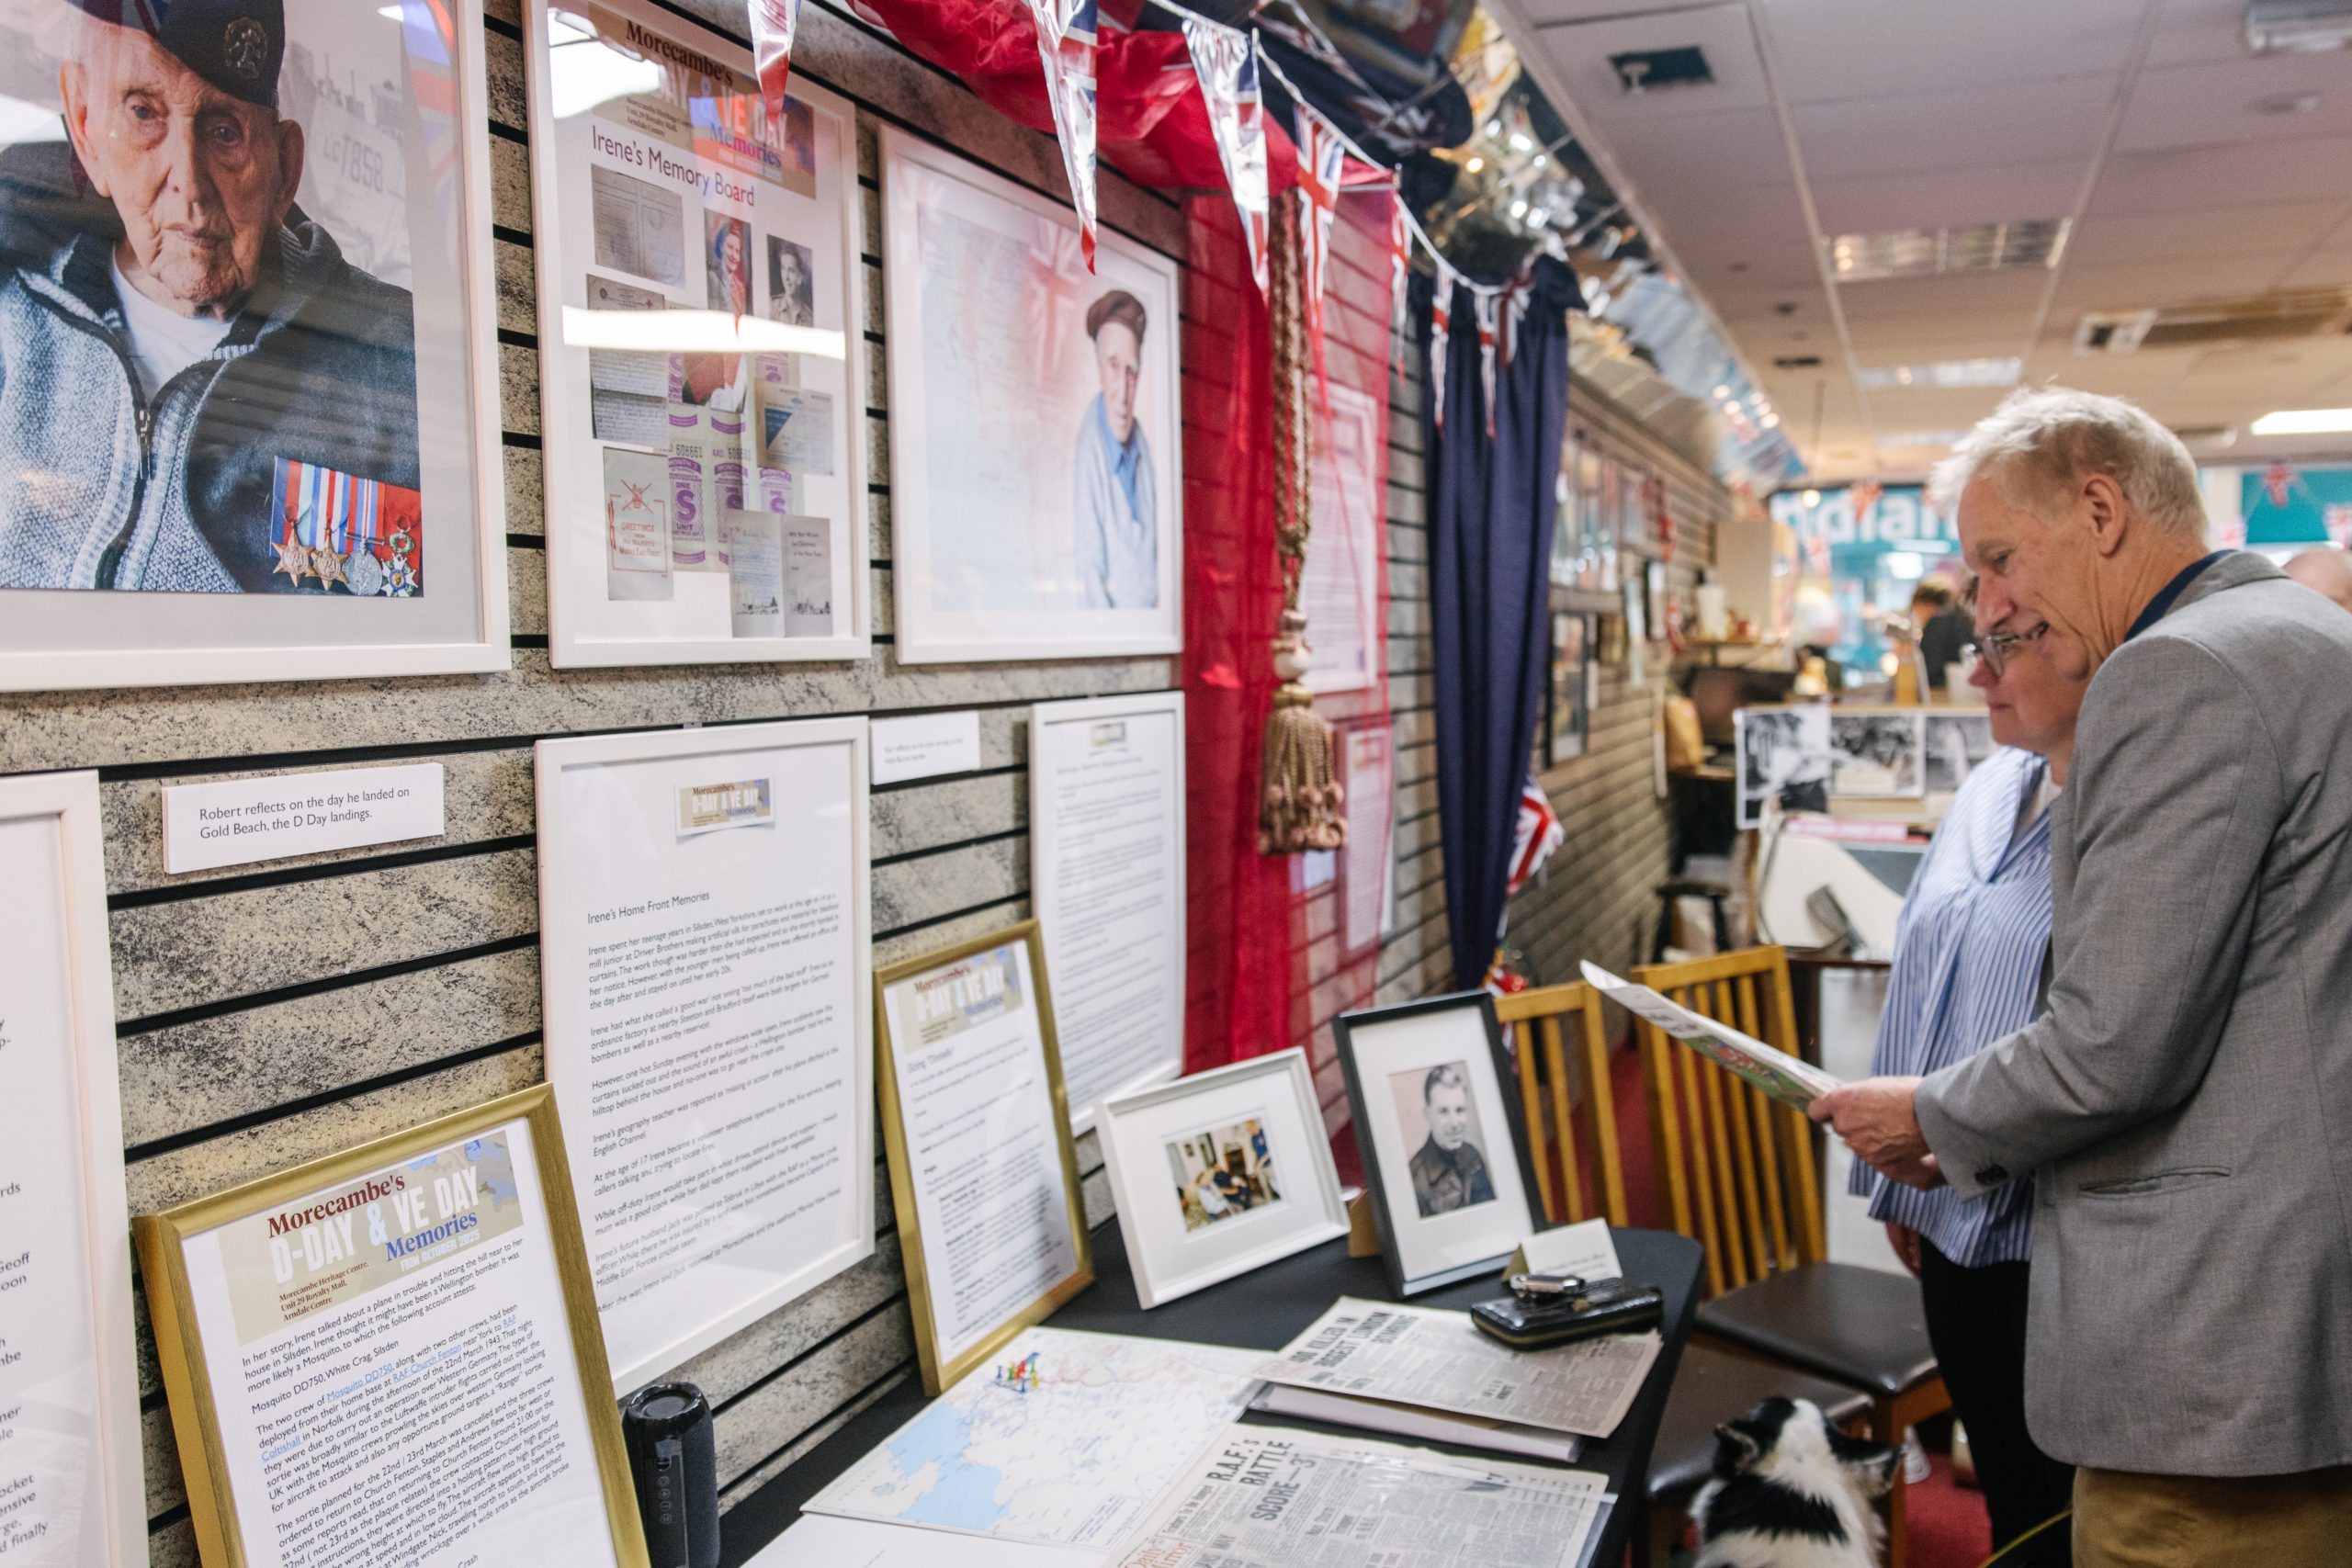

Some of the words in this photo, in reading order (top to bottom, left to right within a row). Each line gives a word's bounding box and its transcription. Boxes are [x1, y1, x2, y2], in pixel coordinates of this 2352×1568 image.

[626, 20, 733, 86] Morecambe's
[593, 124, 643, 166] Irene's
[648, 146, 710, 196] Memory
[715, 172, 755, 208] Board
[709, 120, 782, 167] Memories
[676, 490, 696, 524] S
[199, 807, 241, 821] Robert
[245, 802, 286, 815] reflects
[289, 801, 303, 810] on
[307, 795, 324, 808] the
[327, 794, 345, 808] day
[347, 793, 359, 804] he
[362, 787, 394, 802] landed
[397, 788, 410, 797] on
[200, 824, 230, 839] Gold
[233, 820, 270, 835] Beach,
[272, 818, 290, 830] the
[293, 815, 303, 828] D
[307, 813, 327, 827] Day
[330, 809, 373, 823] landings.
[587, 908, 616, 924] Irene's
[618, 905, 645, 918] Home
[647, 899, 670, 911] Front
[672, 892, 709, 907] Memories
[588, 945, 607, 955] Irene
[608, 941, 627, 953] spent
[628, 938, 640, 947] her
[641, 932, 666, 943] teenage
[667, 928, 684, 940] years
[588, 958, 602, 969] mill
[603, 955, 624, 968] junior
[625, 953, 632, 961] at
[633, 948, 655, 959] Driver
[656, 942, 684, 953] Brothers
[593, 1141, 617, 1156] English
[619, 1132, 646, 1147] Channel.
[268, 1176, 404, 1237] Morecambe's
[268, 1212, 356, 1285] D-DAY
[366, 1202, 388, 1247] &
[391, 1184, 429, 1235] VE
[436, 1166, 481, 1220] DAY
[386, 1210, 478, 1262] Memories
[242, 1358, 251, 1367] In
[253, 1351, 266, 1362] her
[294, 1330, 316, 1344] Irene
[317, 1316, 342, 1334] talked
[343, 1308, 365, 1323] about
[372, 1296, 392, 1312] plane
[402, 1280, 428, 1296] trouble
[429, 1272, 443, 1284] and
[443, 1264, 465, 1278] hitting
[465, 1259, 477, 1269] the
[477, 1252, 488, 1262] hill
[488, 1247, 502, 1258] near
[512, 1238, 522, 1247] her
[279, 1282, 318, 1303] Morecambe
[318, 1270, 345, 1286] Heritage
[345, 1262, 369, 1274] Centre,
[280, 1300, 297, 1312] Unit
[296, 1296, 305, 1306] 29
[305, 1288, 330, 1303] Royalty
[331, 1279, 347, 1292] Mall,
[244, 1363, 271, 1380] house
[272, 1359, 281, 1368] in
[313, 1335, 334, 1349] Irene
[336, 1320, 366, 1338] thought
[367, 1316, 374, 1325] it
[374, 1307, 396, 1321] might
[396, 1300, 413, 1312] have
[413, 1292, 432, 1303] been
[437, 1271, 473, 1292] Wellington
[507, 1251, 519, 1261] was
[283, 1305, 310, 1322] Arndale
[310, 1297, 333, 1310] Centre
[247, 1377, 271, 1393] more
[272, 1366, 294, 1382] likely
[295, 1363, 301, 1371] a
[343, 1340, 352, 1349] to
[353, 1328, 376, 1344] which
[377, 1318, 390, 1334] the
[390, 1307, 424, 1326] following
[424, 1294, 452, 1312] account
[251, 1391, 291, 1415] Mosquito
[324, 1363, 351, 1379] White
[373, 1340, 399, 1357] Silsden
[256, 1423, 274, 1435] The
[275, 1414, 292, 1427] two
[294, 1403, 314, 1417] crew
[316, 1394, 325, 1406] of
[326, 1380, 363, 1403] Mosquito
[395, 1354, 415, 1369] along
[415, 1345, 432, 1358] with
[433, 1338, 447, 1350] two
[447, 1328, 466, 1342] other
[489, 1310, 502, 1322] had
[502, 1303, 517, 1315] been
[1238, 1440, 1295, 1486] BATTLE
[12, 1522, 48, 1547] finally
